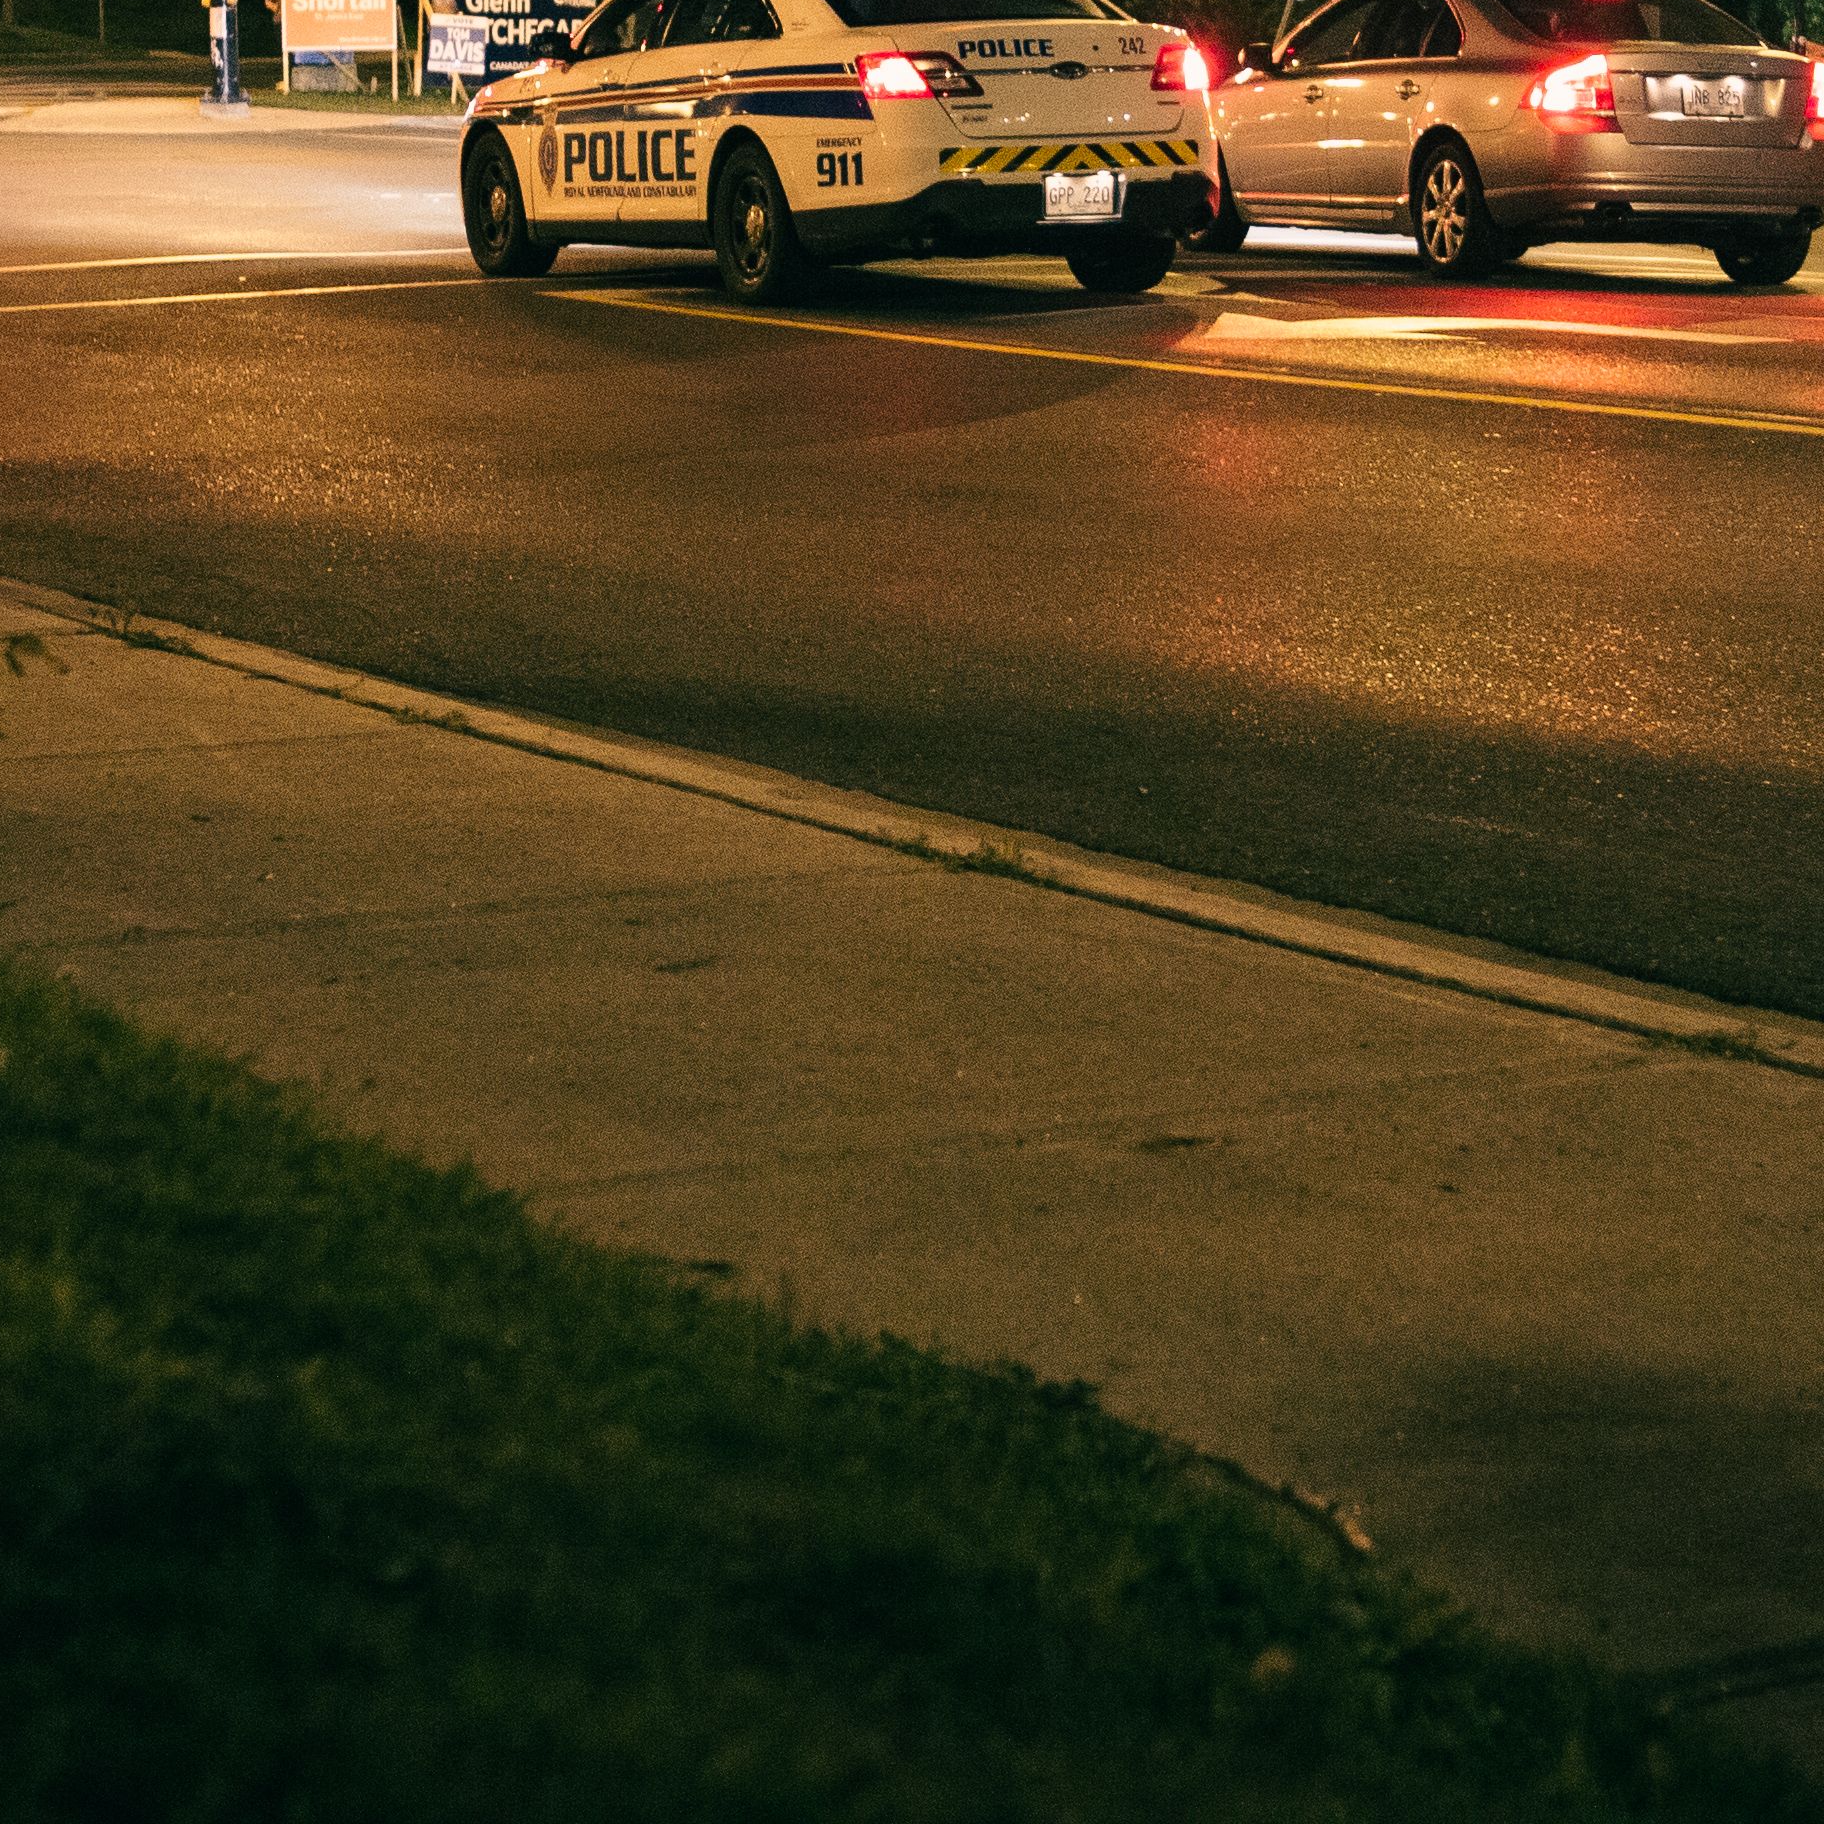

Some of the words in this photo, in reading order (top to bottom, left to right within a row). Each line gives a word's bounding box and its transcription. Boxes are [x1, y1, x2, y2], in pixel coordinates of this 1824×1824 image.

[446, 27, 471, 41] TOM
[430, 39, 484, 62] DAVIS
[957, 39, 1055, 58] POLICE
[1117, 37, 1147, 54] 242
[816, 137, 862, 147] EMERGENCY
[564, 129, 697, 182] POLICE
[816, 151, 863, 187] 911
[1049, 186, 1074, 205] GPP
[1083, 186, 1110, 204] 220
